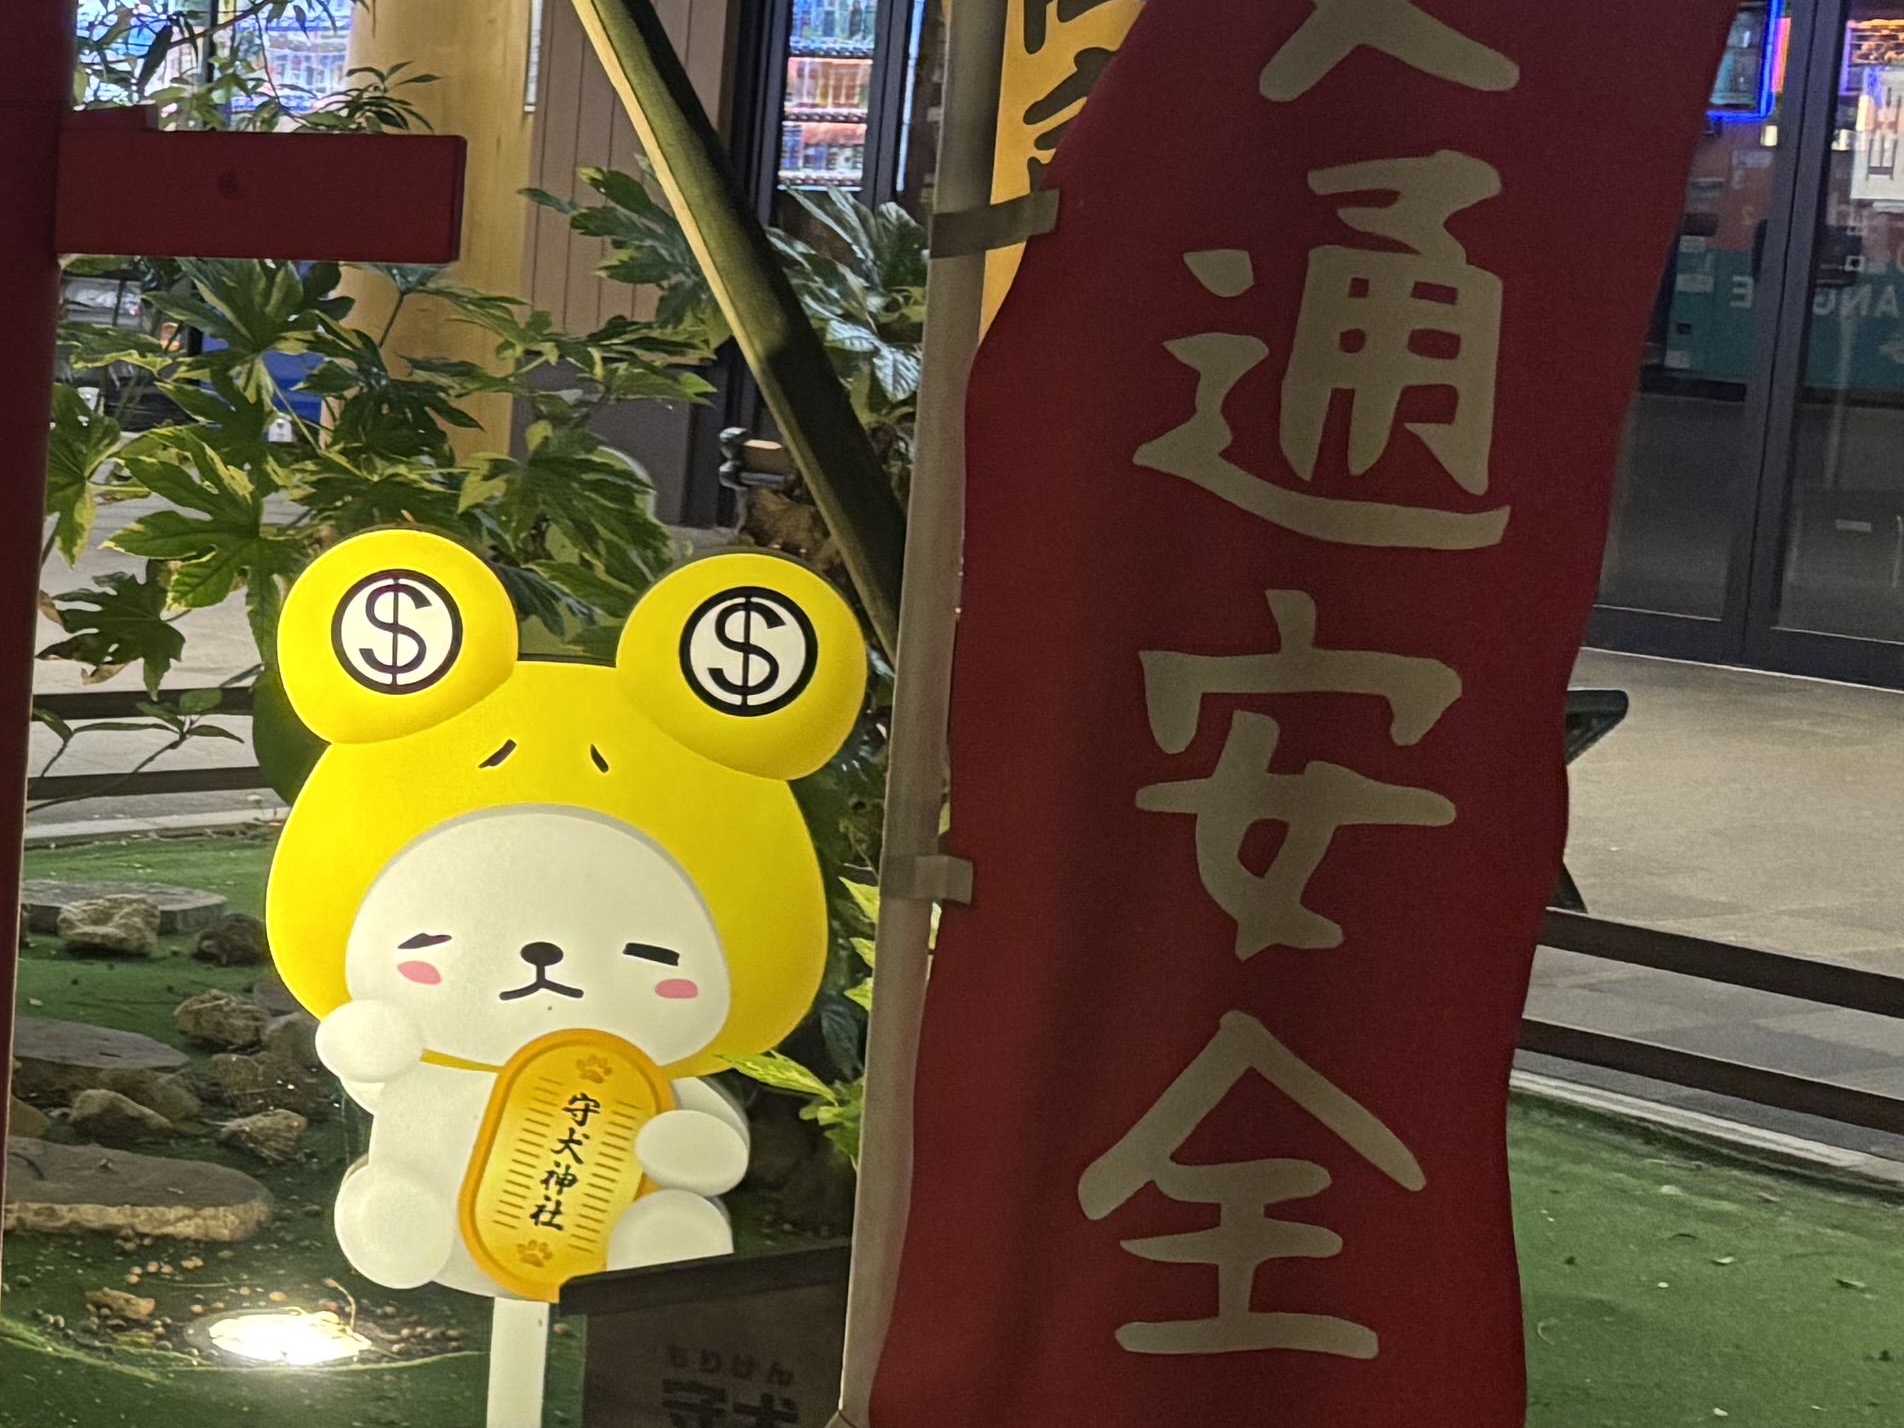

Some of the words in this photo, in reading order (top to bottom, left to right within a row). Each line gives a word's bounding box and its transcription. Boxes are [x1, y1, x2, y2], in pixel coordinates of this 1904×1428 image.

[528, 1091, 603, 1234] 守犬神社
[663, 1341, 795, 1388] もりけん
